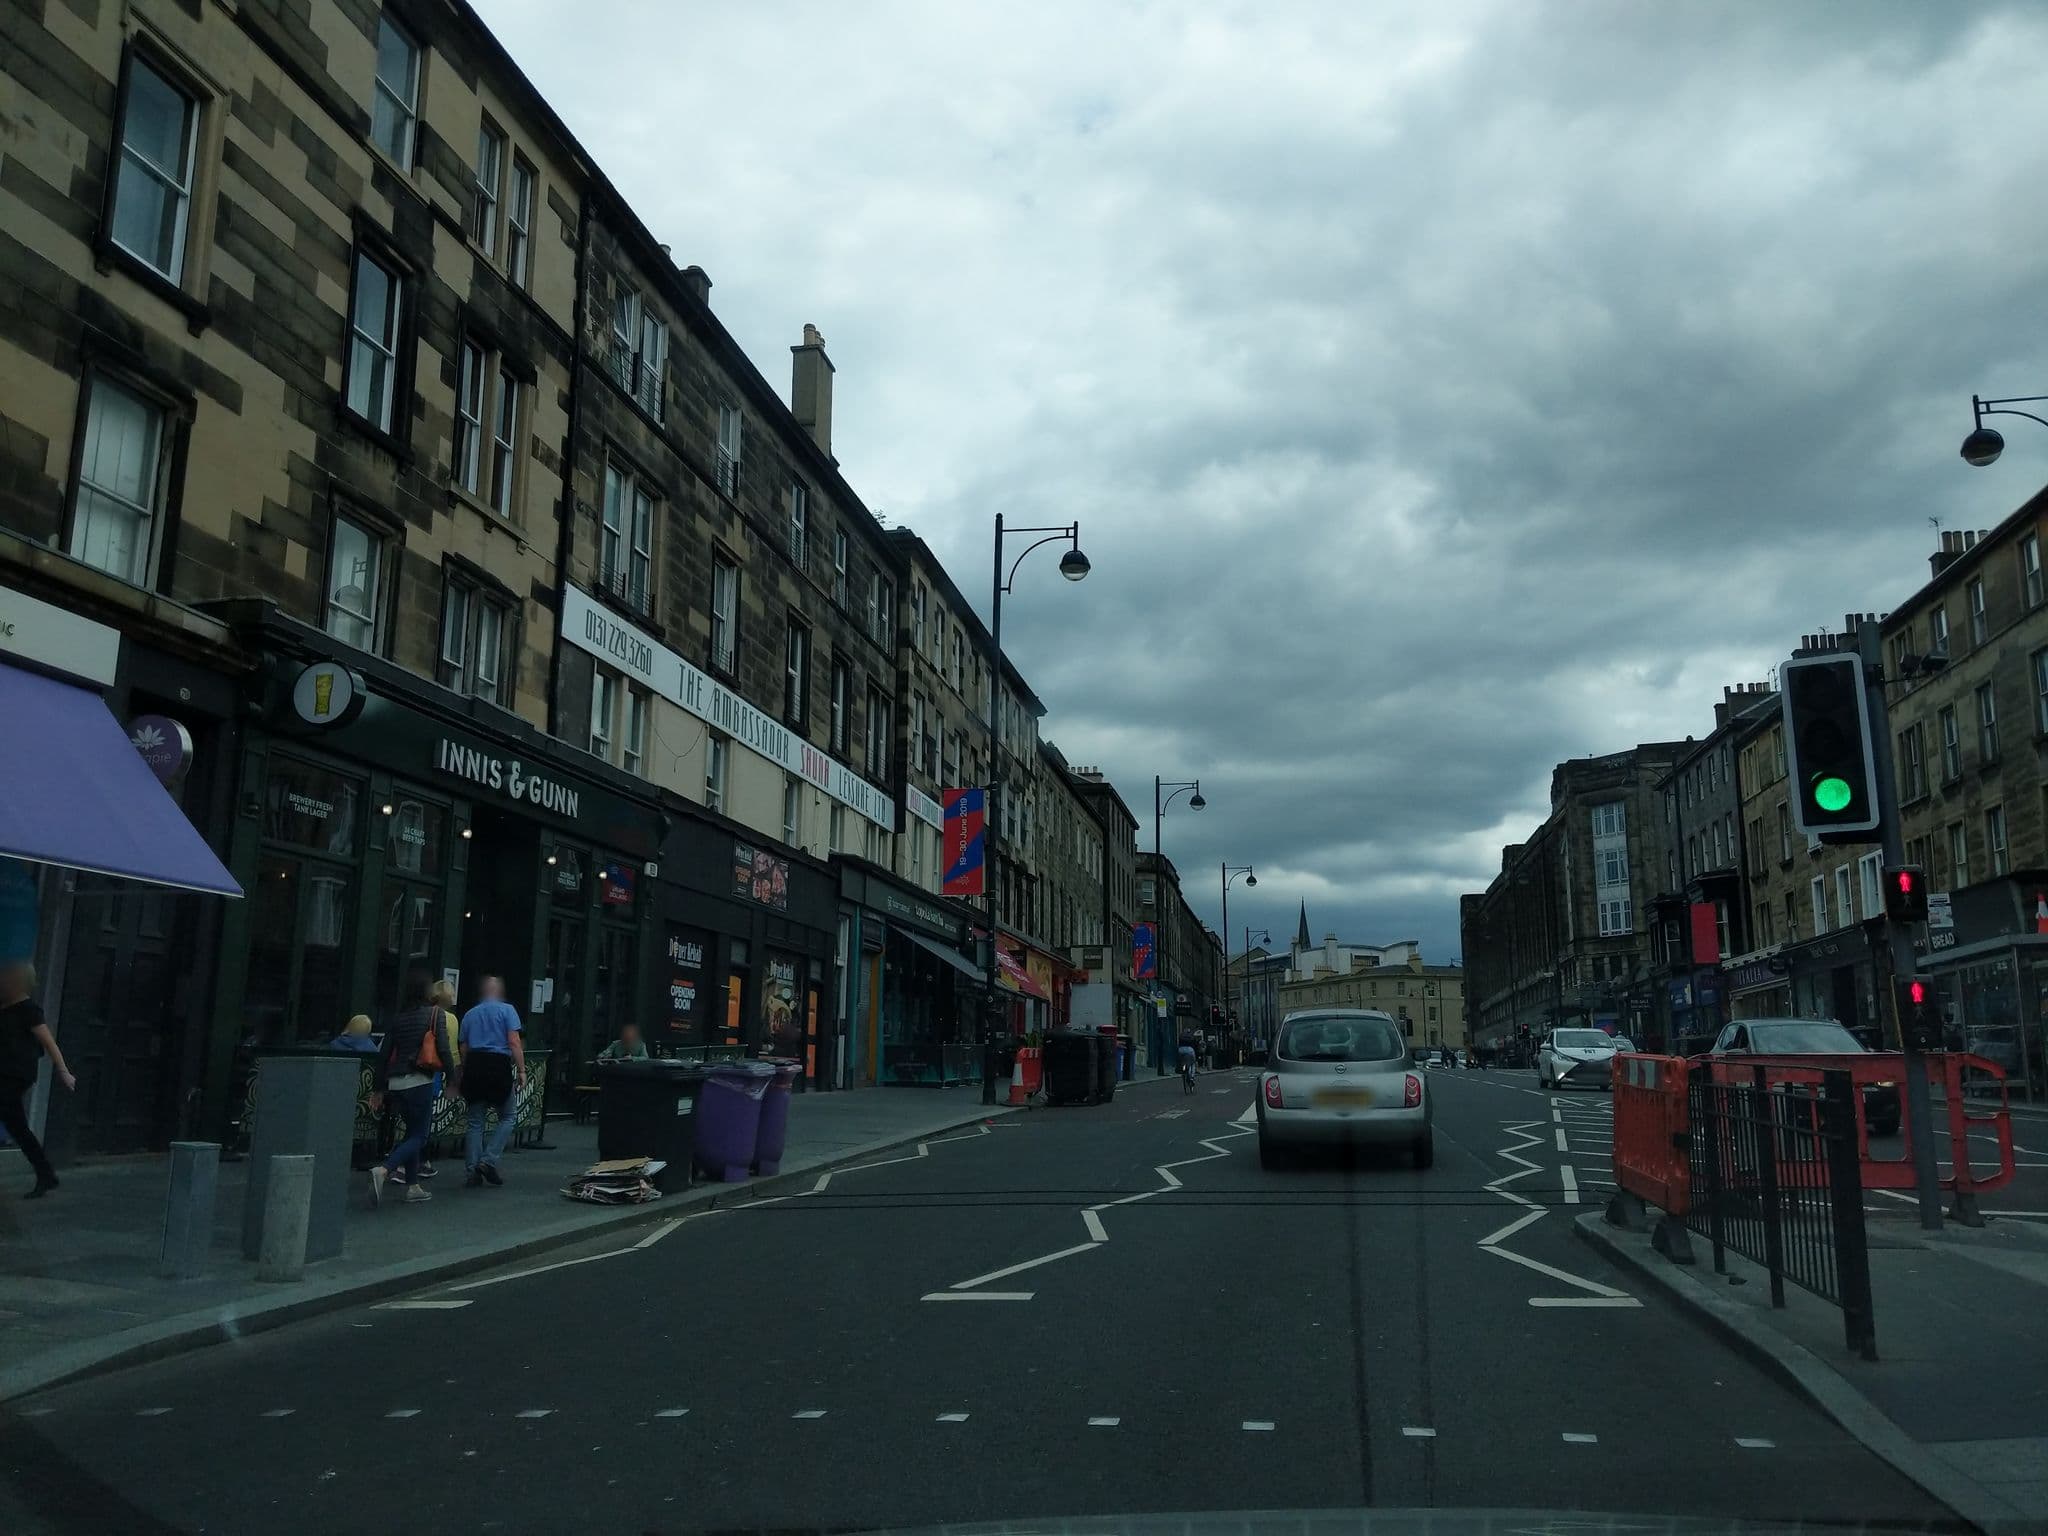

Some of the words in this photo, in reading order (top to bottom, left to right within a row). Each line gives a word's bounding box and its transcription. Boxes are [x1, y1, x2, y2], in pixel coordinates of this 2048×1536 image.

[585, 608, 606, 649] 0131
[608, 623, 627, 660] 229
[628, 636, 652, 676] 3260
[679, 663, 702, 711] THE
[713, 687, 789, 764] AMBASSADOR
[800, 743, 830, 789] SAUNA
[839, 769, 869, 813] LEISURE
[874, 793, 885, 823] LTD
[440, 738, 502, 789] INNIS
[509, 761, 526, 799] &
[529, 775, 579, 818] GUNN
[288, 793, 315, 806] BREWERY
[315, 800, 334, 812] FRESH
[295, 803, 309, 814] TANK
[310, 807, 328, 818] LAGER
[960, 797, 968, 817] 2019
[960, 819, 968, 839] June
[1931, 933, 1956, 949] BREAD
[671, 985, 696, 1000] OPENING
[674, 998, 691, 1011] SOON
